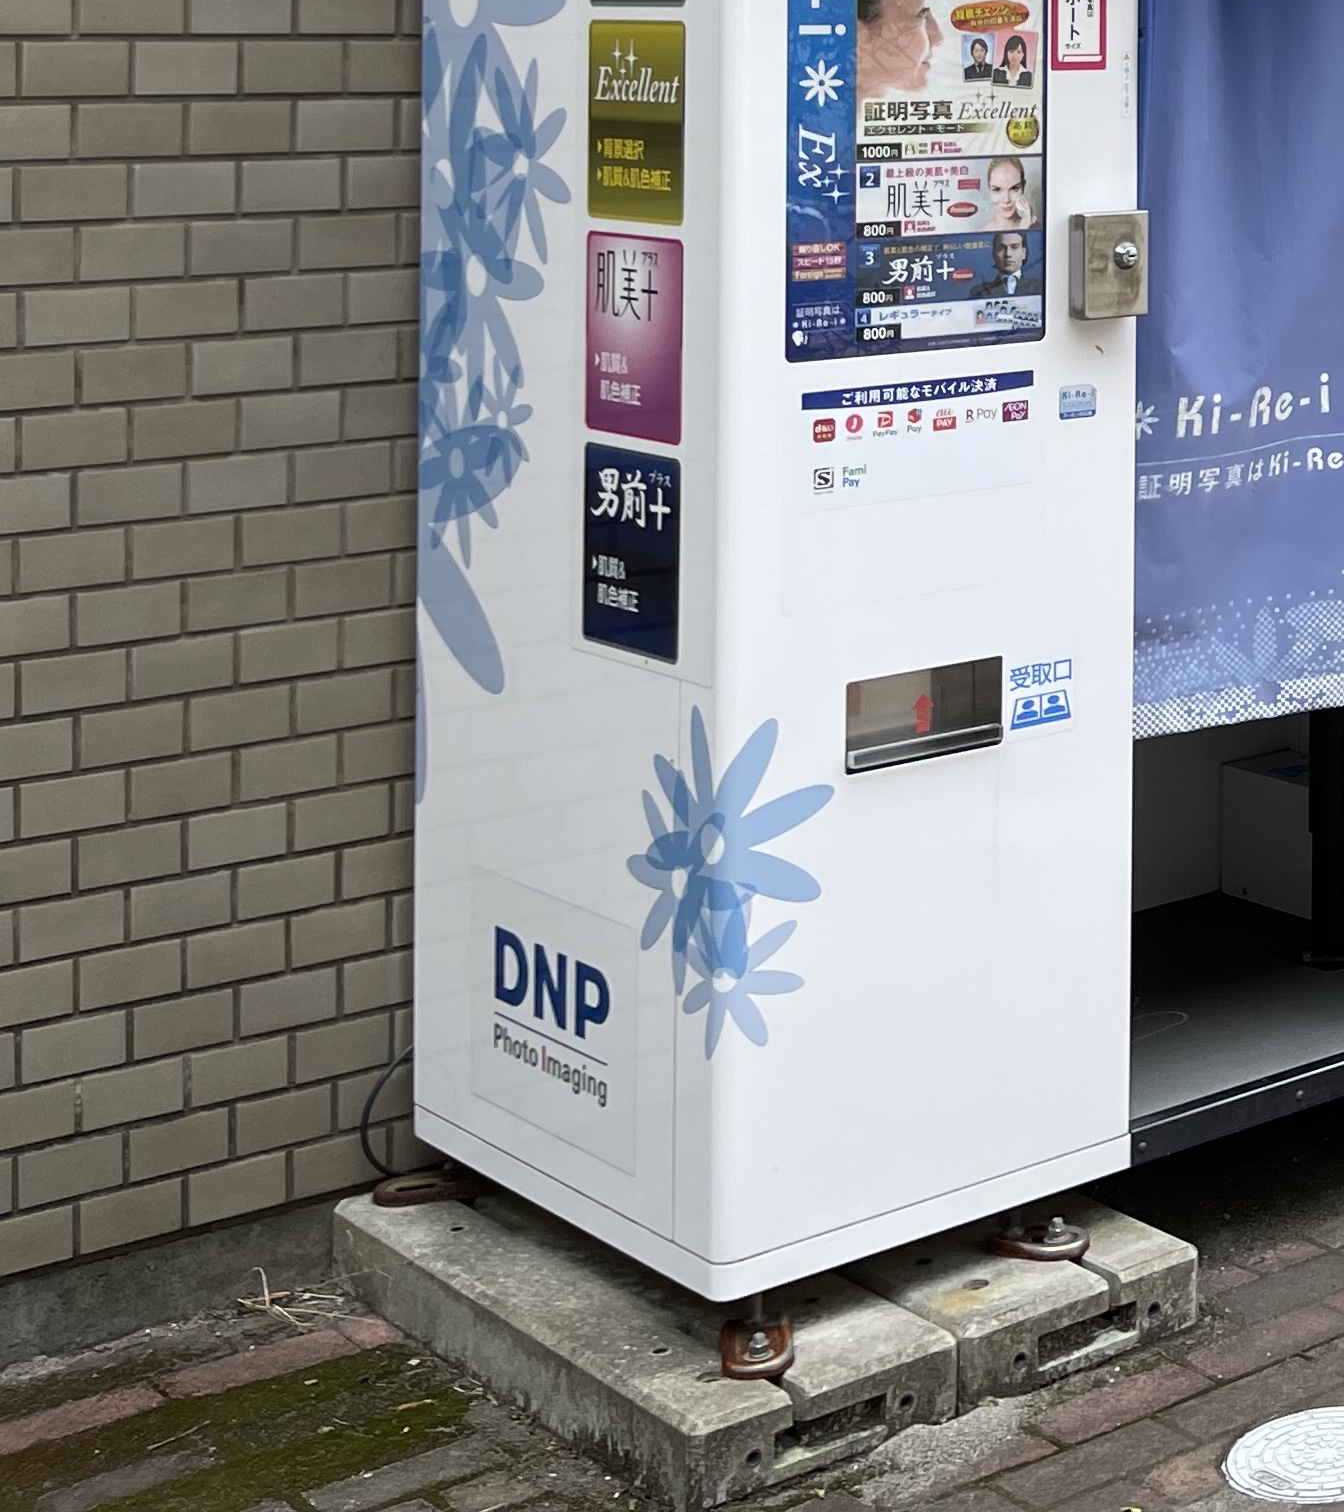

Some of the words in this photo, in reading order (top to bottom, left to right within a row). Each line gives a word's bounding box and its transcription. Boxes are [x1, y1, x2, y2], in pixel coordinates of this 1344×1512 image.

[594, 66, 680, 104] Excellent
[864, 100, 953, 122] 証明写真
[956, 101, 1038, 120] Excellent
[603, 137, 645, 161] 背景選択
[861, 146, 899, 158] 1000円
[865, 172, 875, 186] 2
[863, 224, 895, 237] 800円
[865, 251, 874, 265] 3
[862, 291, 894, 304] 800円
[860, 314, 867, 324] 4
[863, 327, 895, 340] 800円
[840, 377, 998, 406] ご利用可能なモバイル決済
[1175, 372, 1331, 438] Ki-Re-i
[976, 407, 998, 420] Pay
[907, 425, 922, 433] Pay
[842, 478, 860, 488] Pay
[1009, 658, 1072, 691] 受取口
[494, 925, 611, 1039] DNP
[493, 1022, 538, 1067] Photo
[541, 1045, 608, 1107] Imaging
